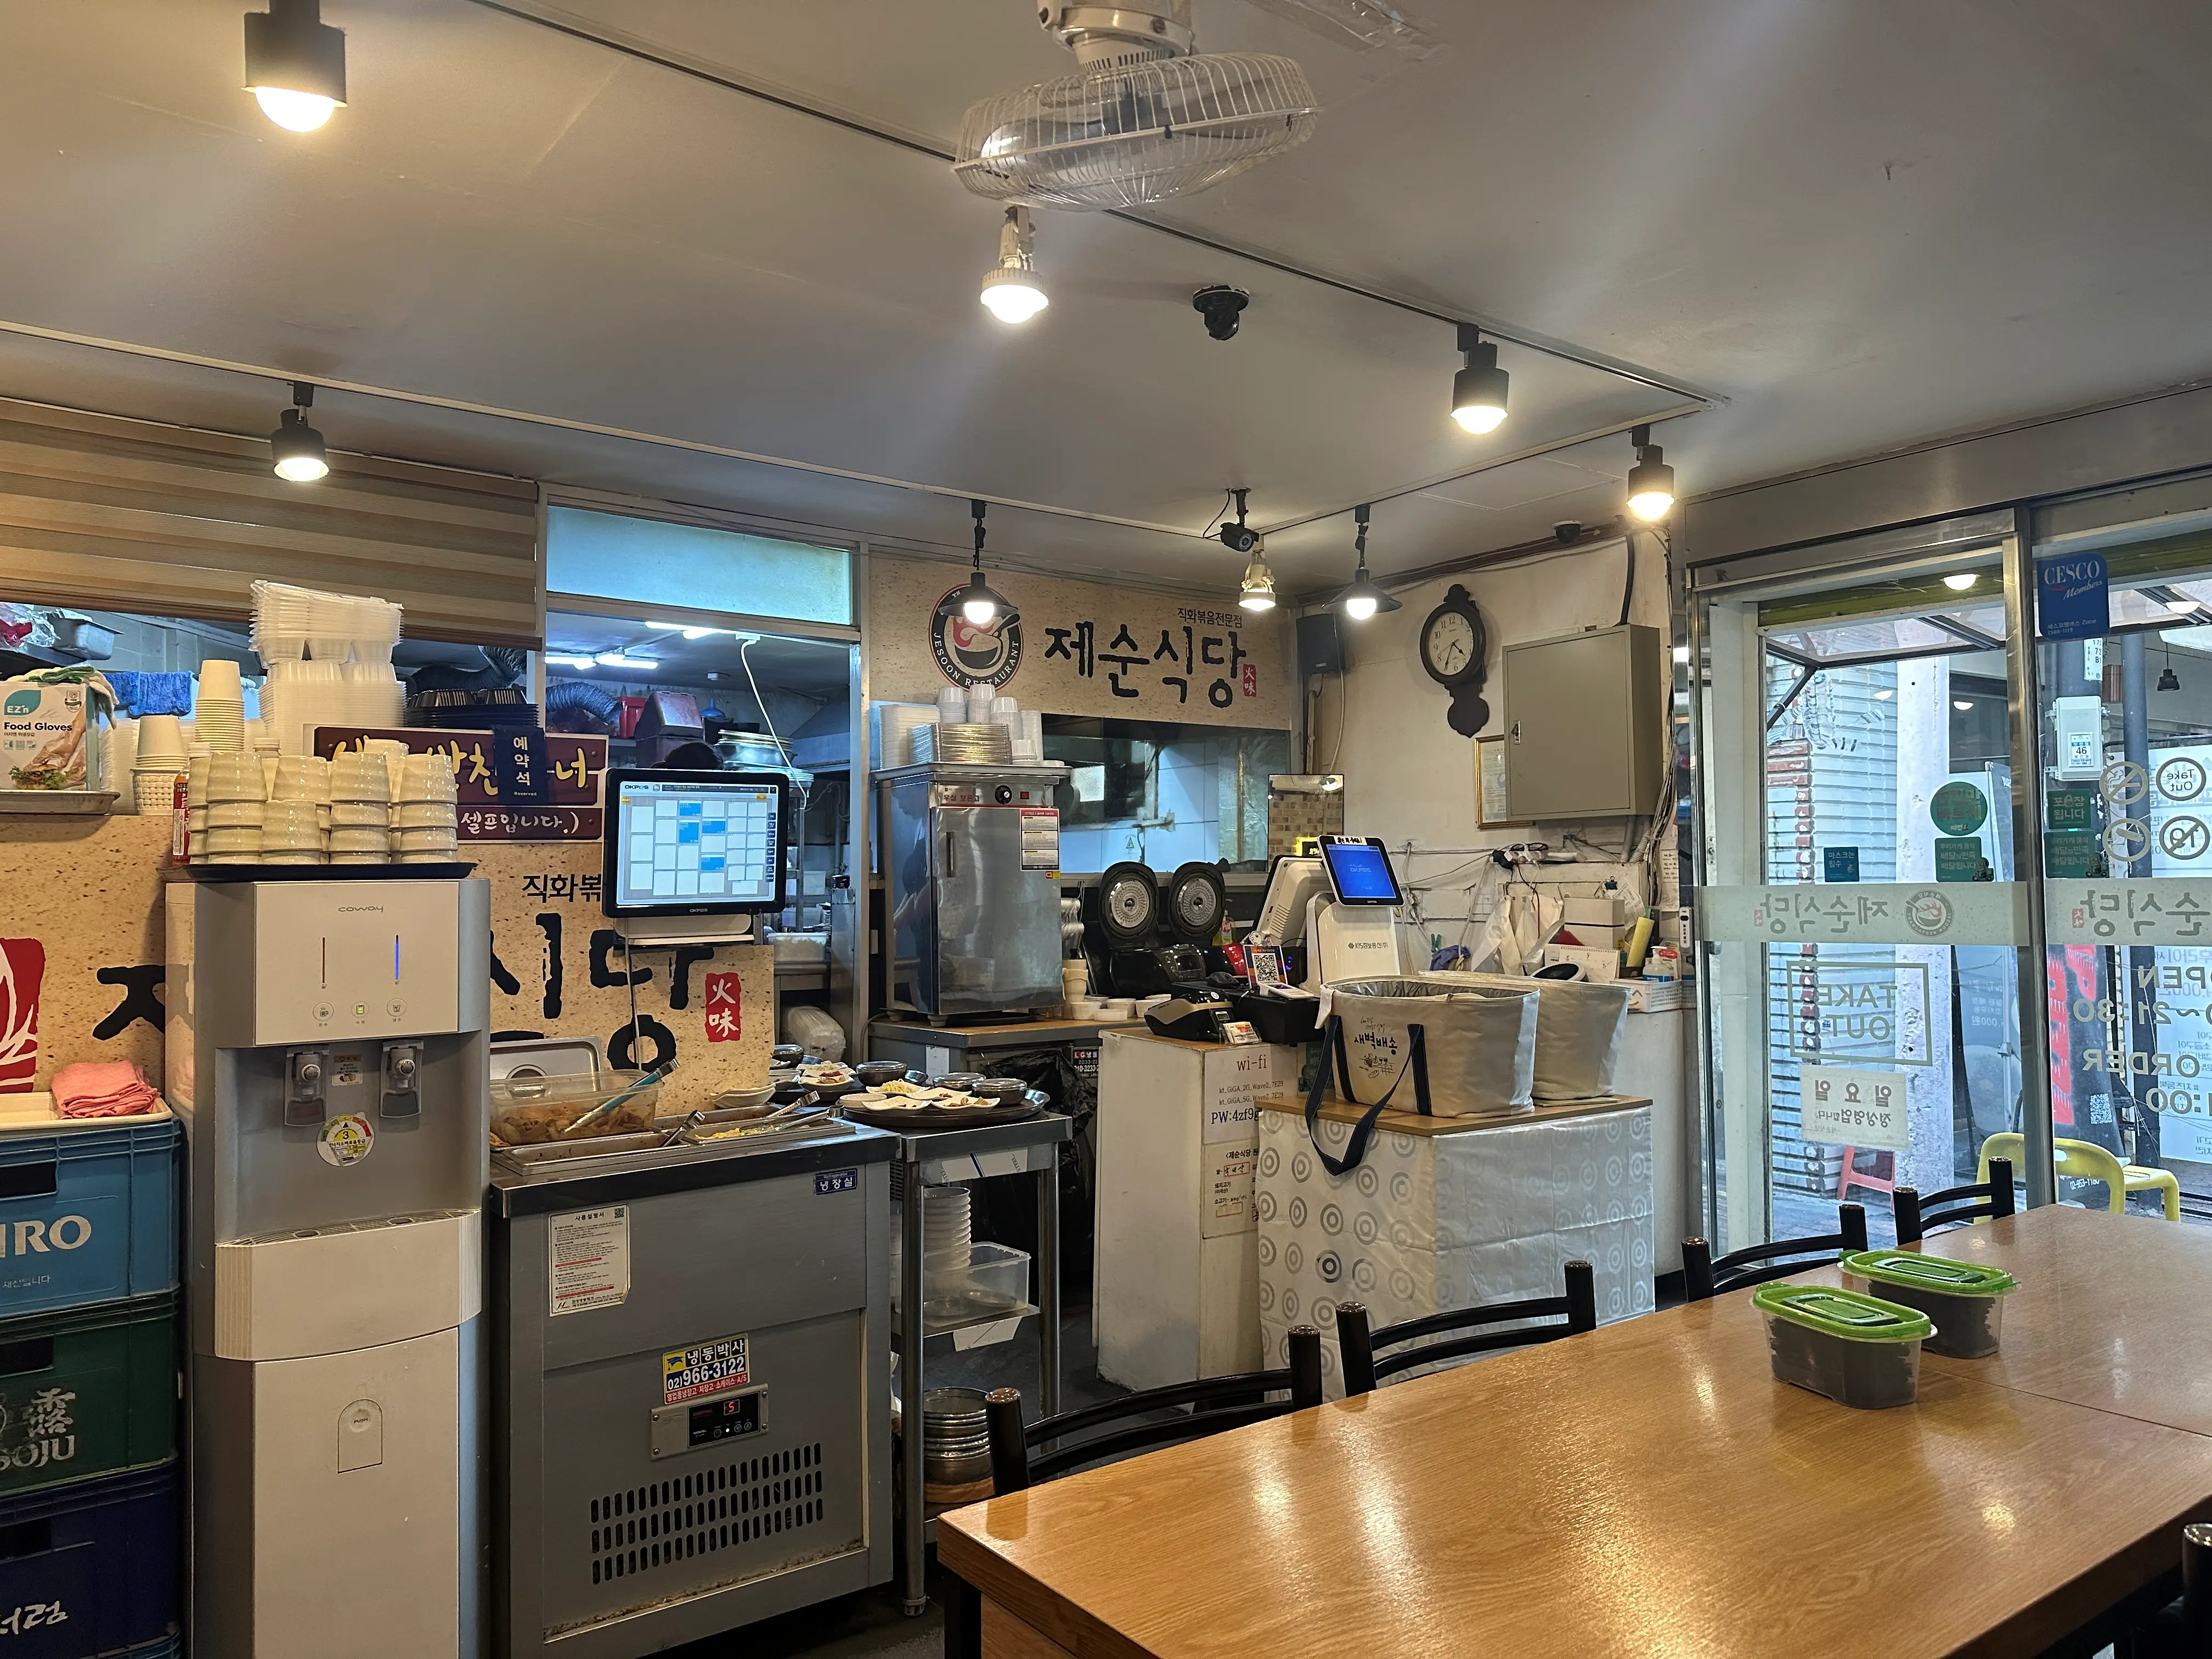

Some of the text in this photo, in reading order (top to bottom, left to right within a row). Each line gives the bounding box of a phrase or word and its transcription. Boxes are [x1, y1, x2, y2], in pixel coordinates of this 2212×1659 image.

[2044, 560, 2100, 585] CESCO
[2063, 579, 2103, 600] Members
[1177, 607, 1243, 628] 직화볶음전문점
[1449, 616, 1455, 625] 12
[1440, 620, 1446, 629] 11
[1435, 631, 1441, 639] 10
[934, 632, 961, 680] JESOON
[1437, 654, 1442, 662] 8
[1045, 620, 1246, 708] 제순식당
[1454, 663, 1458, 672] 6
[4, 722, 72, 731] Food Gloves
[514, 736, 531, 786] 예약석
[2053, 808, 2085, 820] 됩니다
[1940, 851, 1976, 860] 배달의민족
[2051, 845, 2089, 855] 배달의민족
[1829, 859, 1842, 867] 필수
[1941, 861, 1976, 870] 배달됩니다
[1354, 1031, 1397, 1056] 새벽배송
[1237, 1054, 1267, 1071] wi-fi
[1219, 1092, 1284, 1105] kt_GiGA_5G_Wave27E29
[342, 1131, 349, 1140] 3
[820, 1176, 852, 1191] 냉장실
[575, 1211, 605, 1221] 사용설명서
[3, 1274, 51, 1289] 재산입니다
[687, 1339, 744, 1365] 냉동박사
[668, 1356, 744, 1390] 02)966-3122
[729, 1401, 735, 1413] 5
